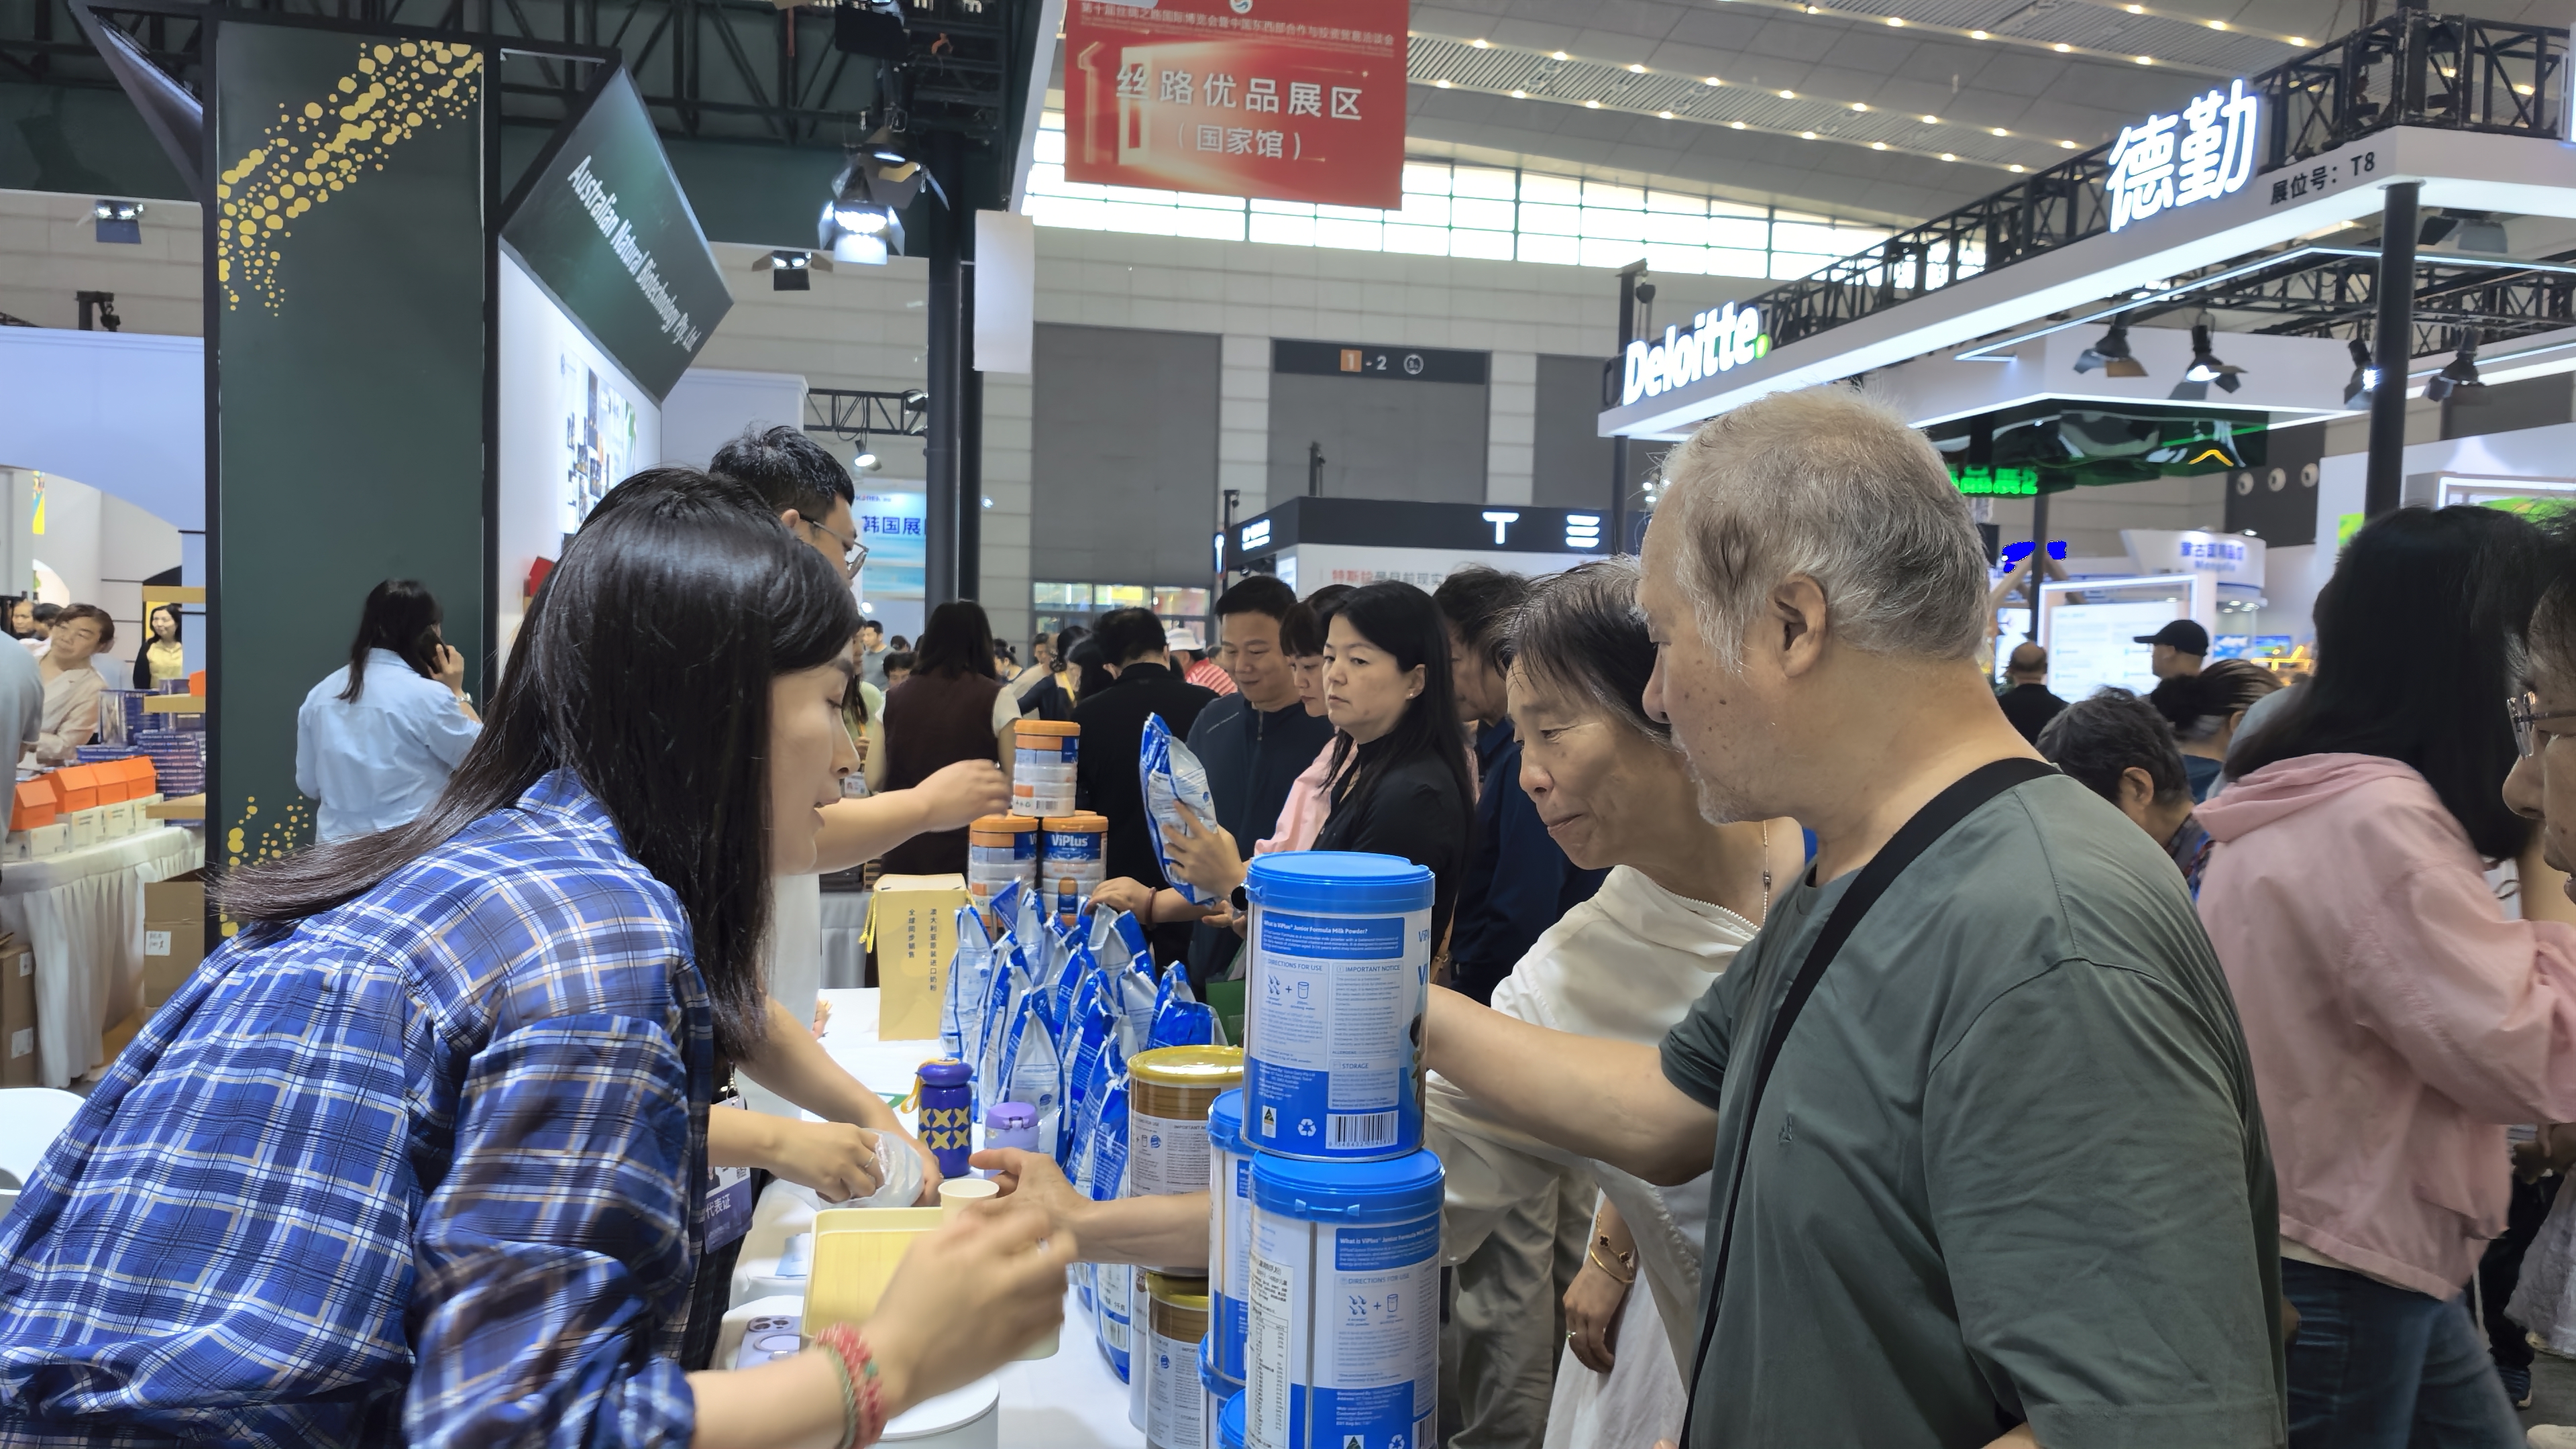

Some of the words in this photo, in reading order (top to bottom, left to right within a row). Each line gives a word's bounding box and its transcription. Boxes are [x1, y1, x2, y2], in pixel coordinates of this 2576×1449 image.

[1116, 66, 1362, 121] 丝路优品展区
[1177, 123, 1301, 160] （国家馆）
[2108, 78, 2261, 233] 德勤
[2271, 165, 2337, 205] 展位号：
[2351, 152, 2375, 176] T8
[567, 155, 620, 238] Australian
[610, 219, 650, 276] Natural
[635, 258, 680, 333] Biotechnology
[861, 515, 926, 535] 韩国展
[1051, 834, 1088, 847] ViPlus
[929, 908, 937, 991] 澳大利亚原装进口奶粉
[1267, 958, 1297, 969] DIRECTIONS
[706, 1193, 731, 1219] 代表证
[1348, 1277, 1386, 1285] DIRECTIONS
